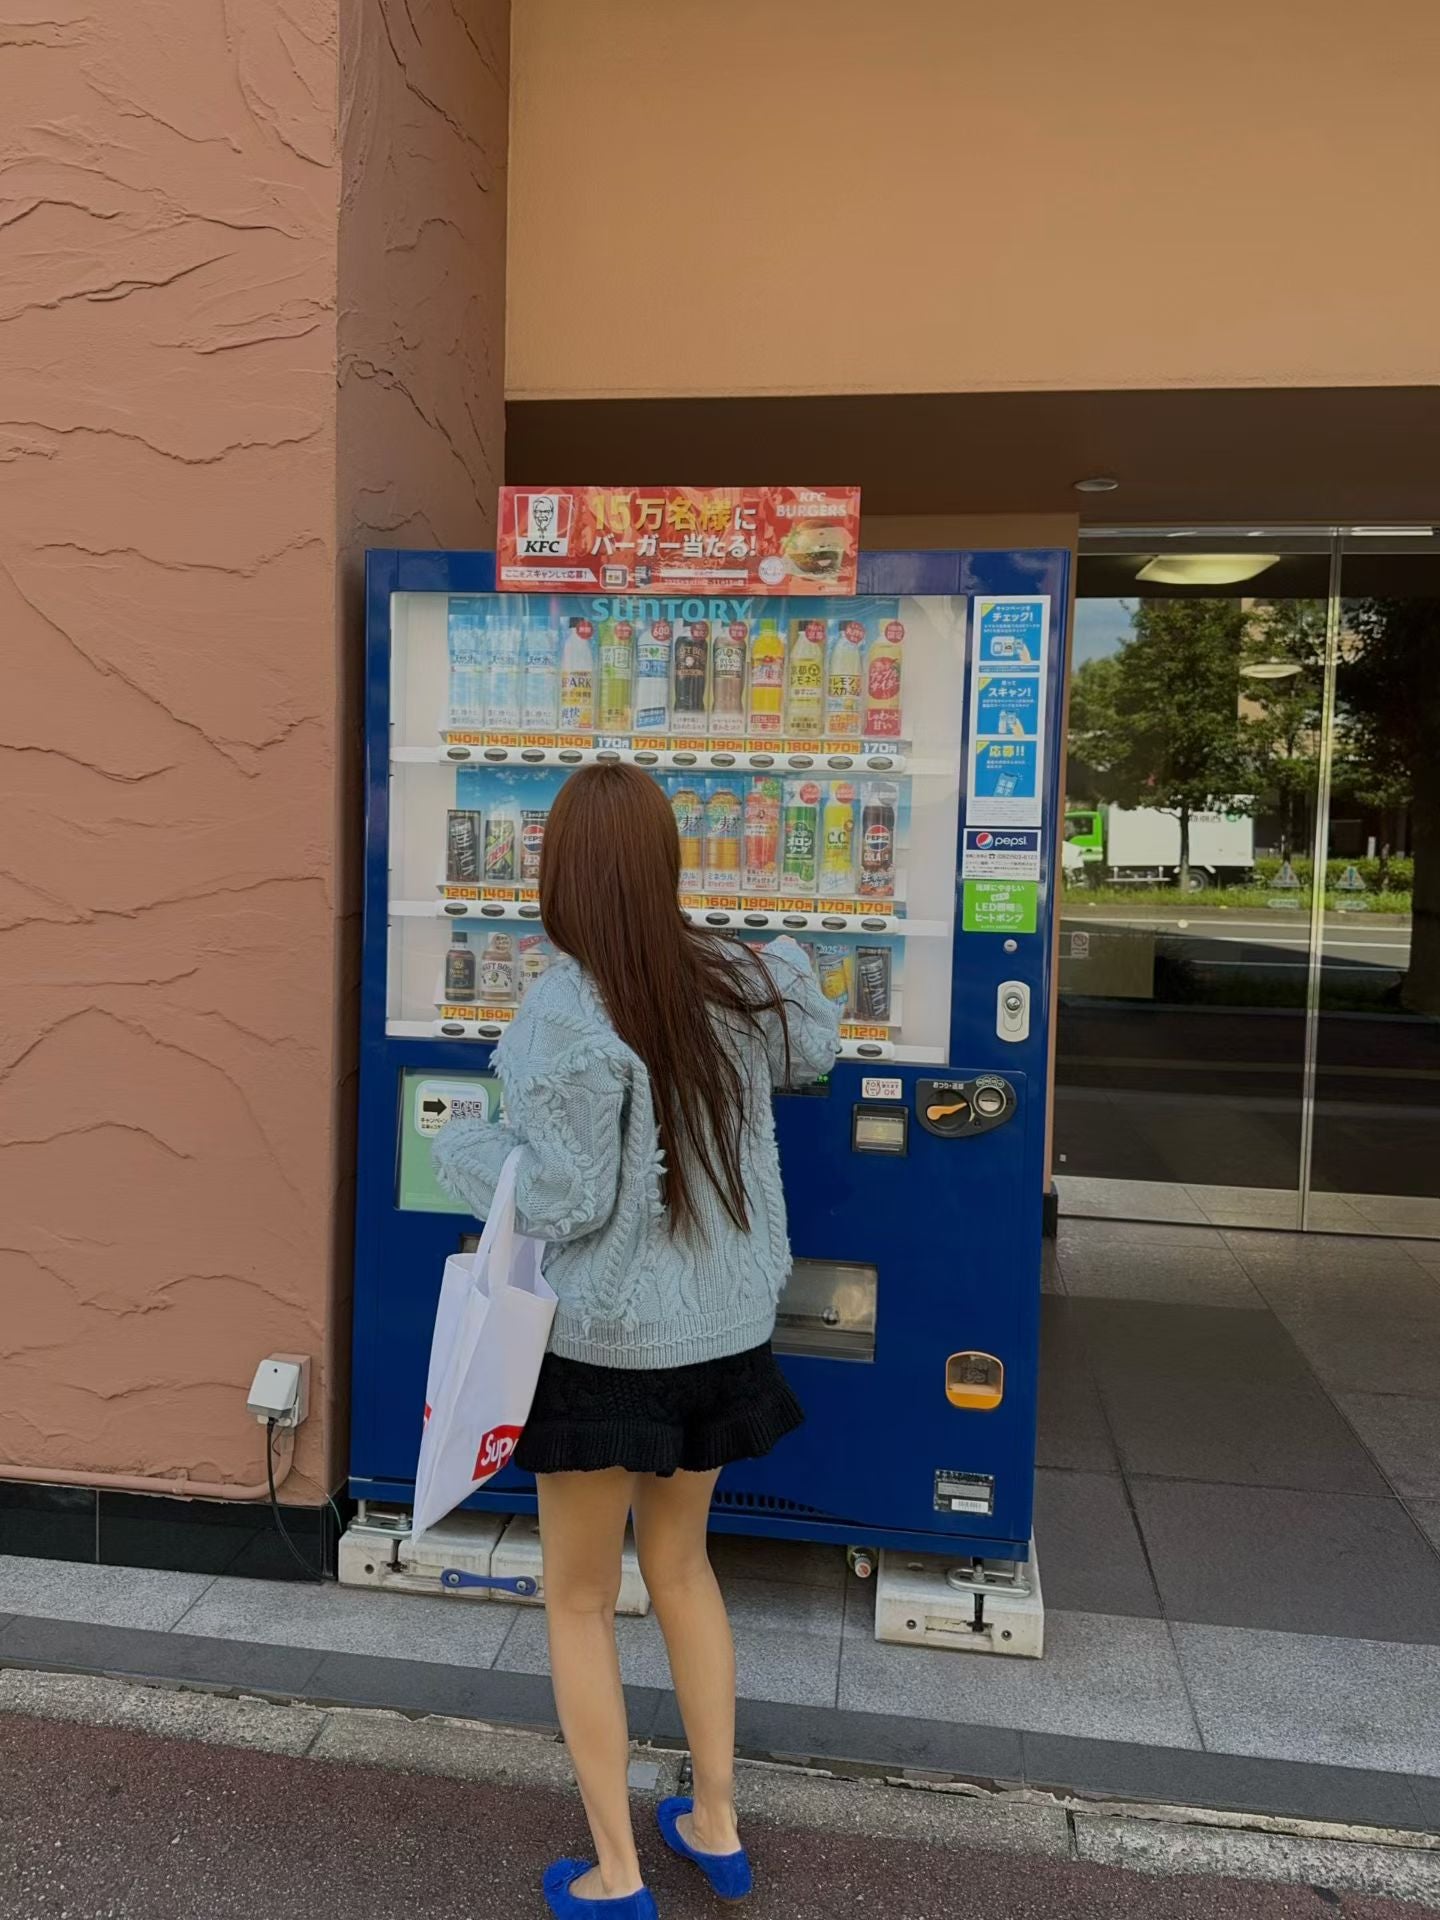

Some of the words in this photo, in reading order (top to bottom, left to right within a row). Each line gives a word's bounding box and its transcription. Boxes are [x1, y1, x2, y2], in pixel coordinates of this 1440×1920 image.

[800, 492, 826, 502] KFC
[592, 494, 757, 532] 15万名様に
[776, 504, 848, 517] BURGERS
[524, 540, 561, 553] KFC
[591, 597, 752, 622] SUNTORY
[992, 612, 1033, 622] チェック!
[988, 687, 1031, 697] スキャン!
[448, 735, 480, 745] 140円
[486, 735, 517, 745] 140円
[524, 736, 555, 746] 140円
[560, 736, 592, 747] 140円
[597, 737, 629, 748] 170円
[634, 738, 665, 749] 170円
[710, 739, 743, 750] 190円
[827, 742, 859, 753] 170円
[863, 742, 897, 754] 170円
[994, 835, 1027, 847] pepsi
[483, 889, 515, 899] 140円
[779, 899, 814, 910] 170円
[820, 900, 853, 912] 170円
[859, 901, 892, 913] 170円
[976, 913, 1024, 922] ヒートポンプ
[854, 1027, 887, 1037] 120円
